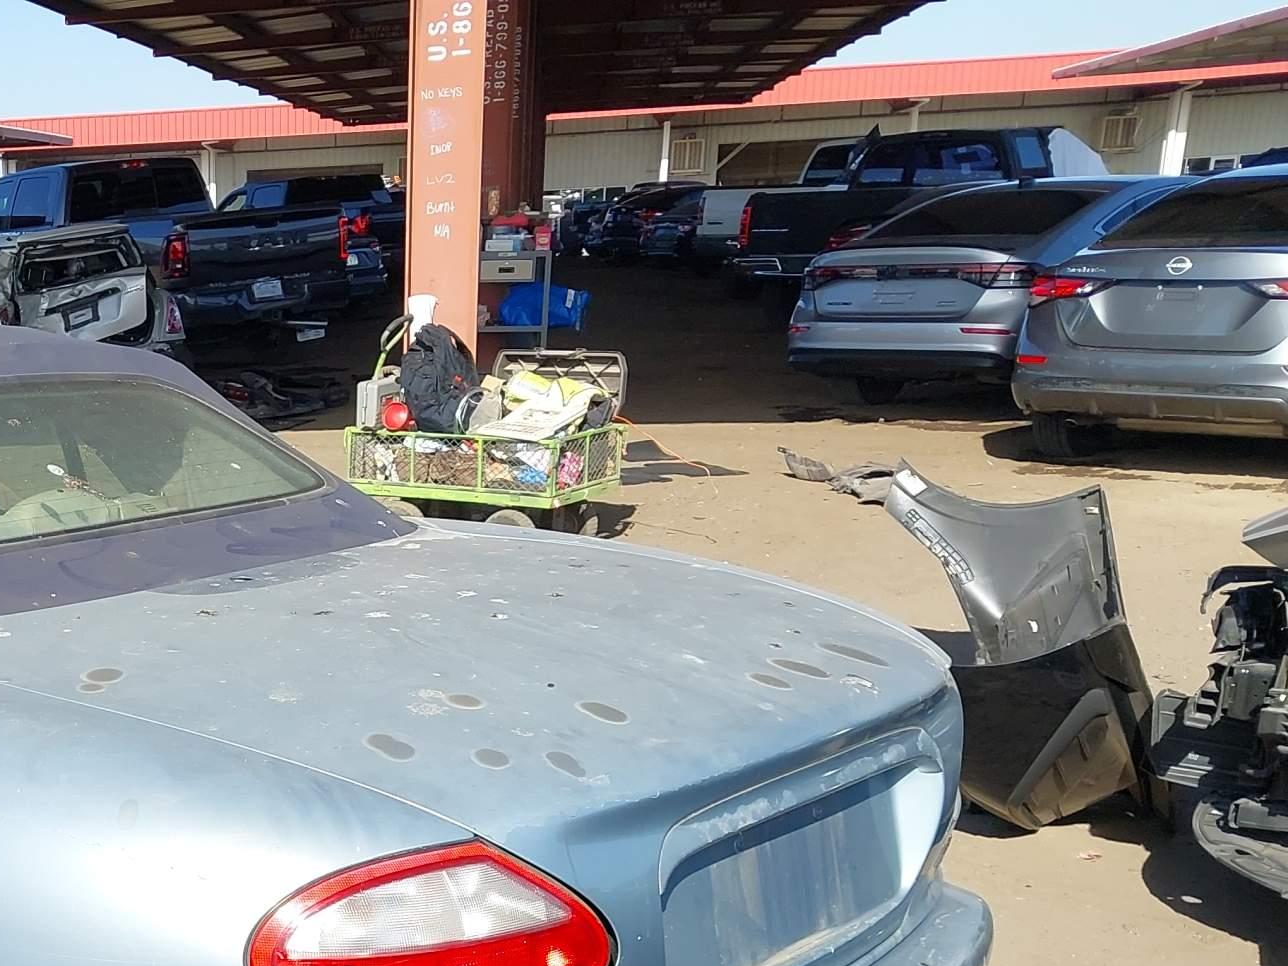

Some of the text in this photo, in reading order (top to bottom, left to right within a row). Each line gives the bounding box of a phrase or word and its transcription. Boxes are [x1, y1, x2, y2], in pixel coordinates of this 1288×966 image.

[427, 12, 448, 62] U.S.
[493, 0, 510, 102] 1-866-799-0
[438, 86, 463, 98] KEYS
[430, 141, 452, 156] INOP
[433, 223, 450, 240] N/A
